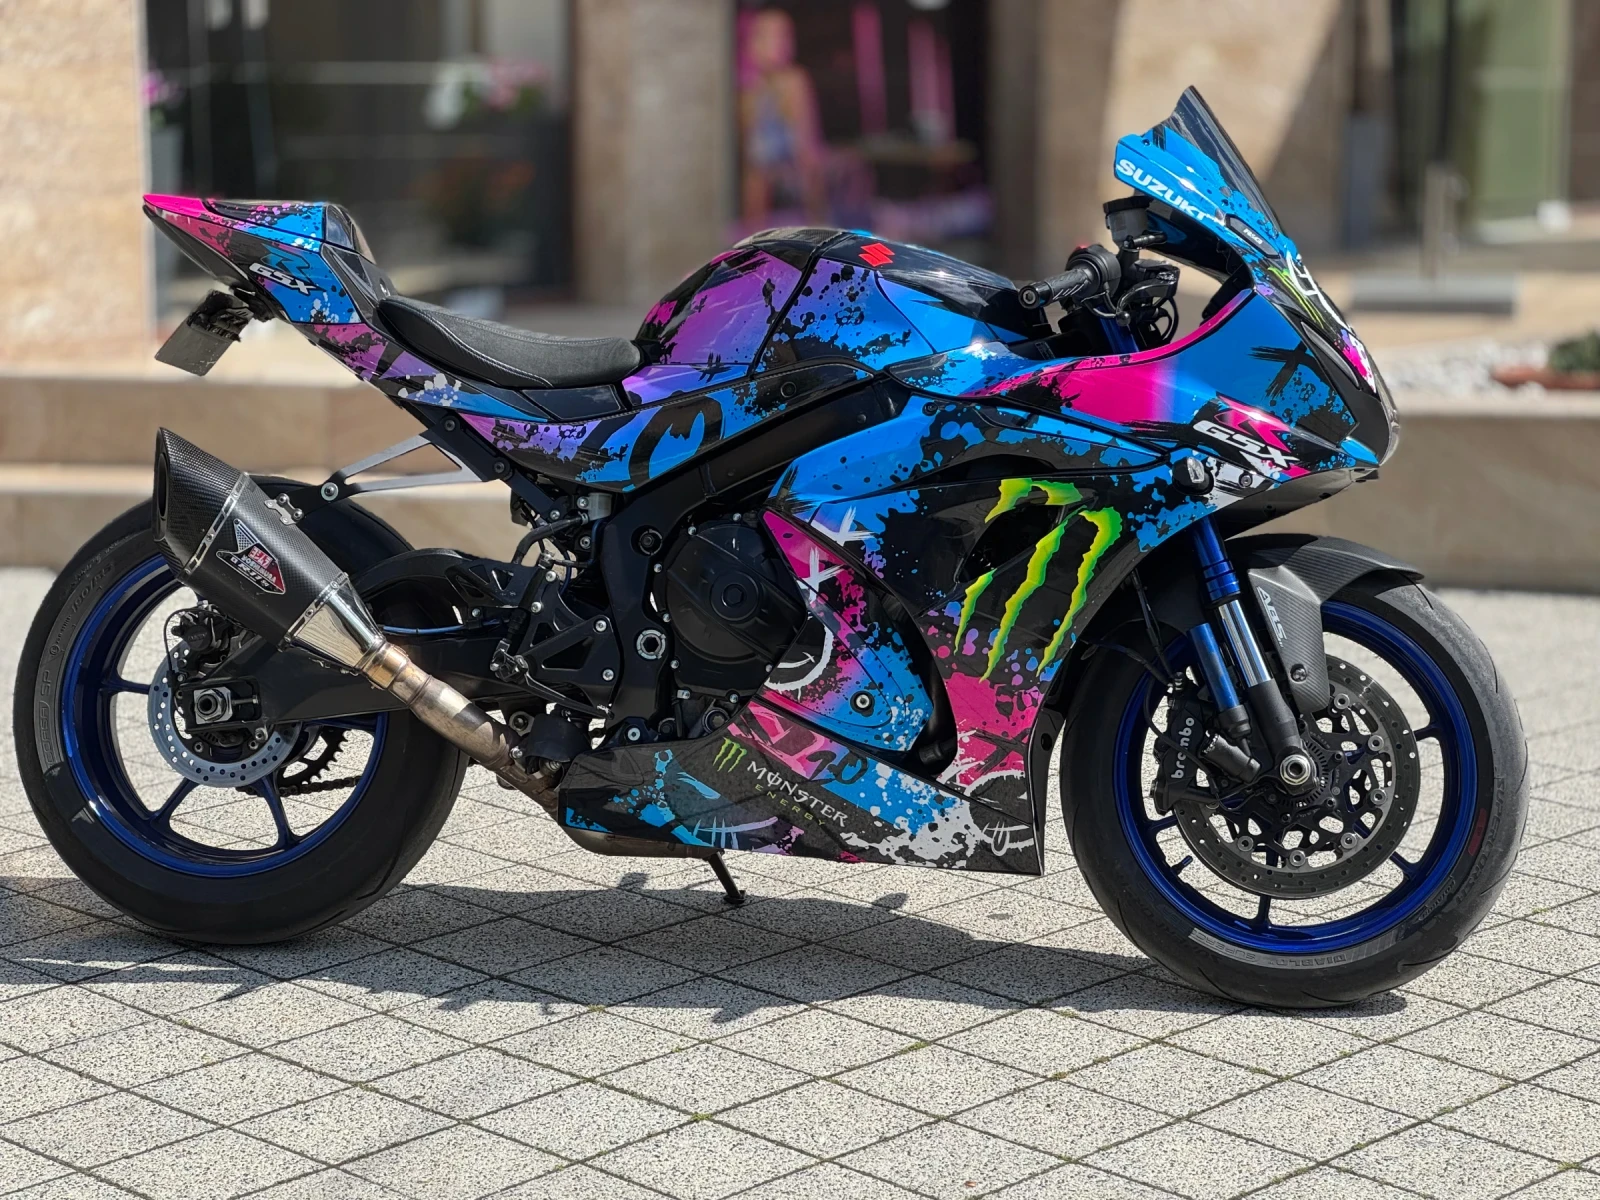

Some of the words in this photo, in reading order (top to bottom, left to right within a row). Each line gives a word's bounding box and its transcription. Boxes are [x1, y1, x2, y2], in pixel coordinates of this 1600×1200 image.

[1116, 158, 1206, 221] SUZUKI
[250, 263, 317, 294] GSX
[1193, 420, 1300, 468] GSX
[754, 784, 825, 827] ENERGY
